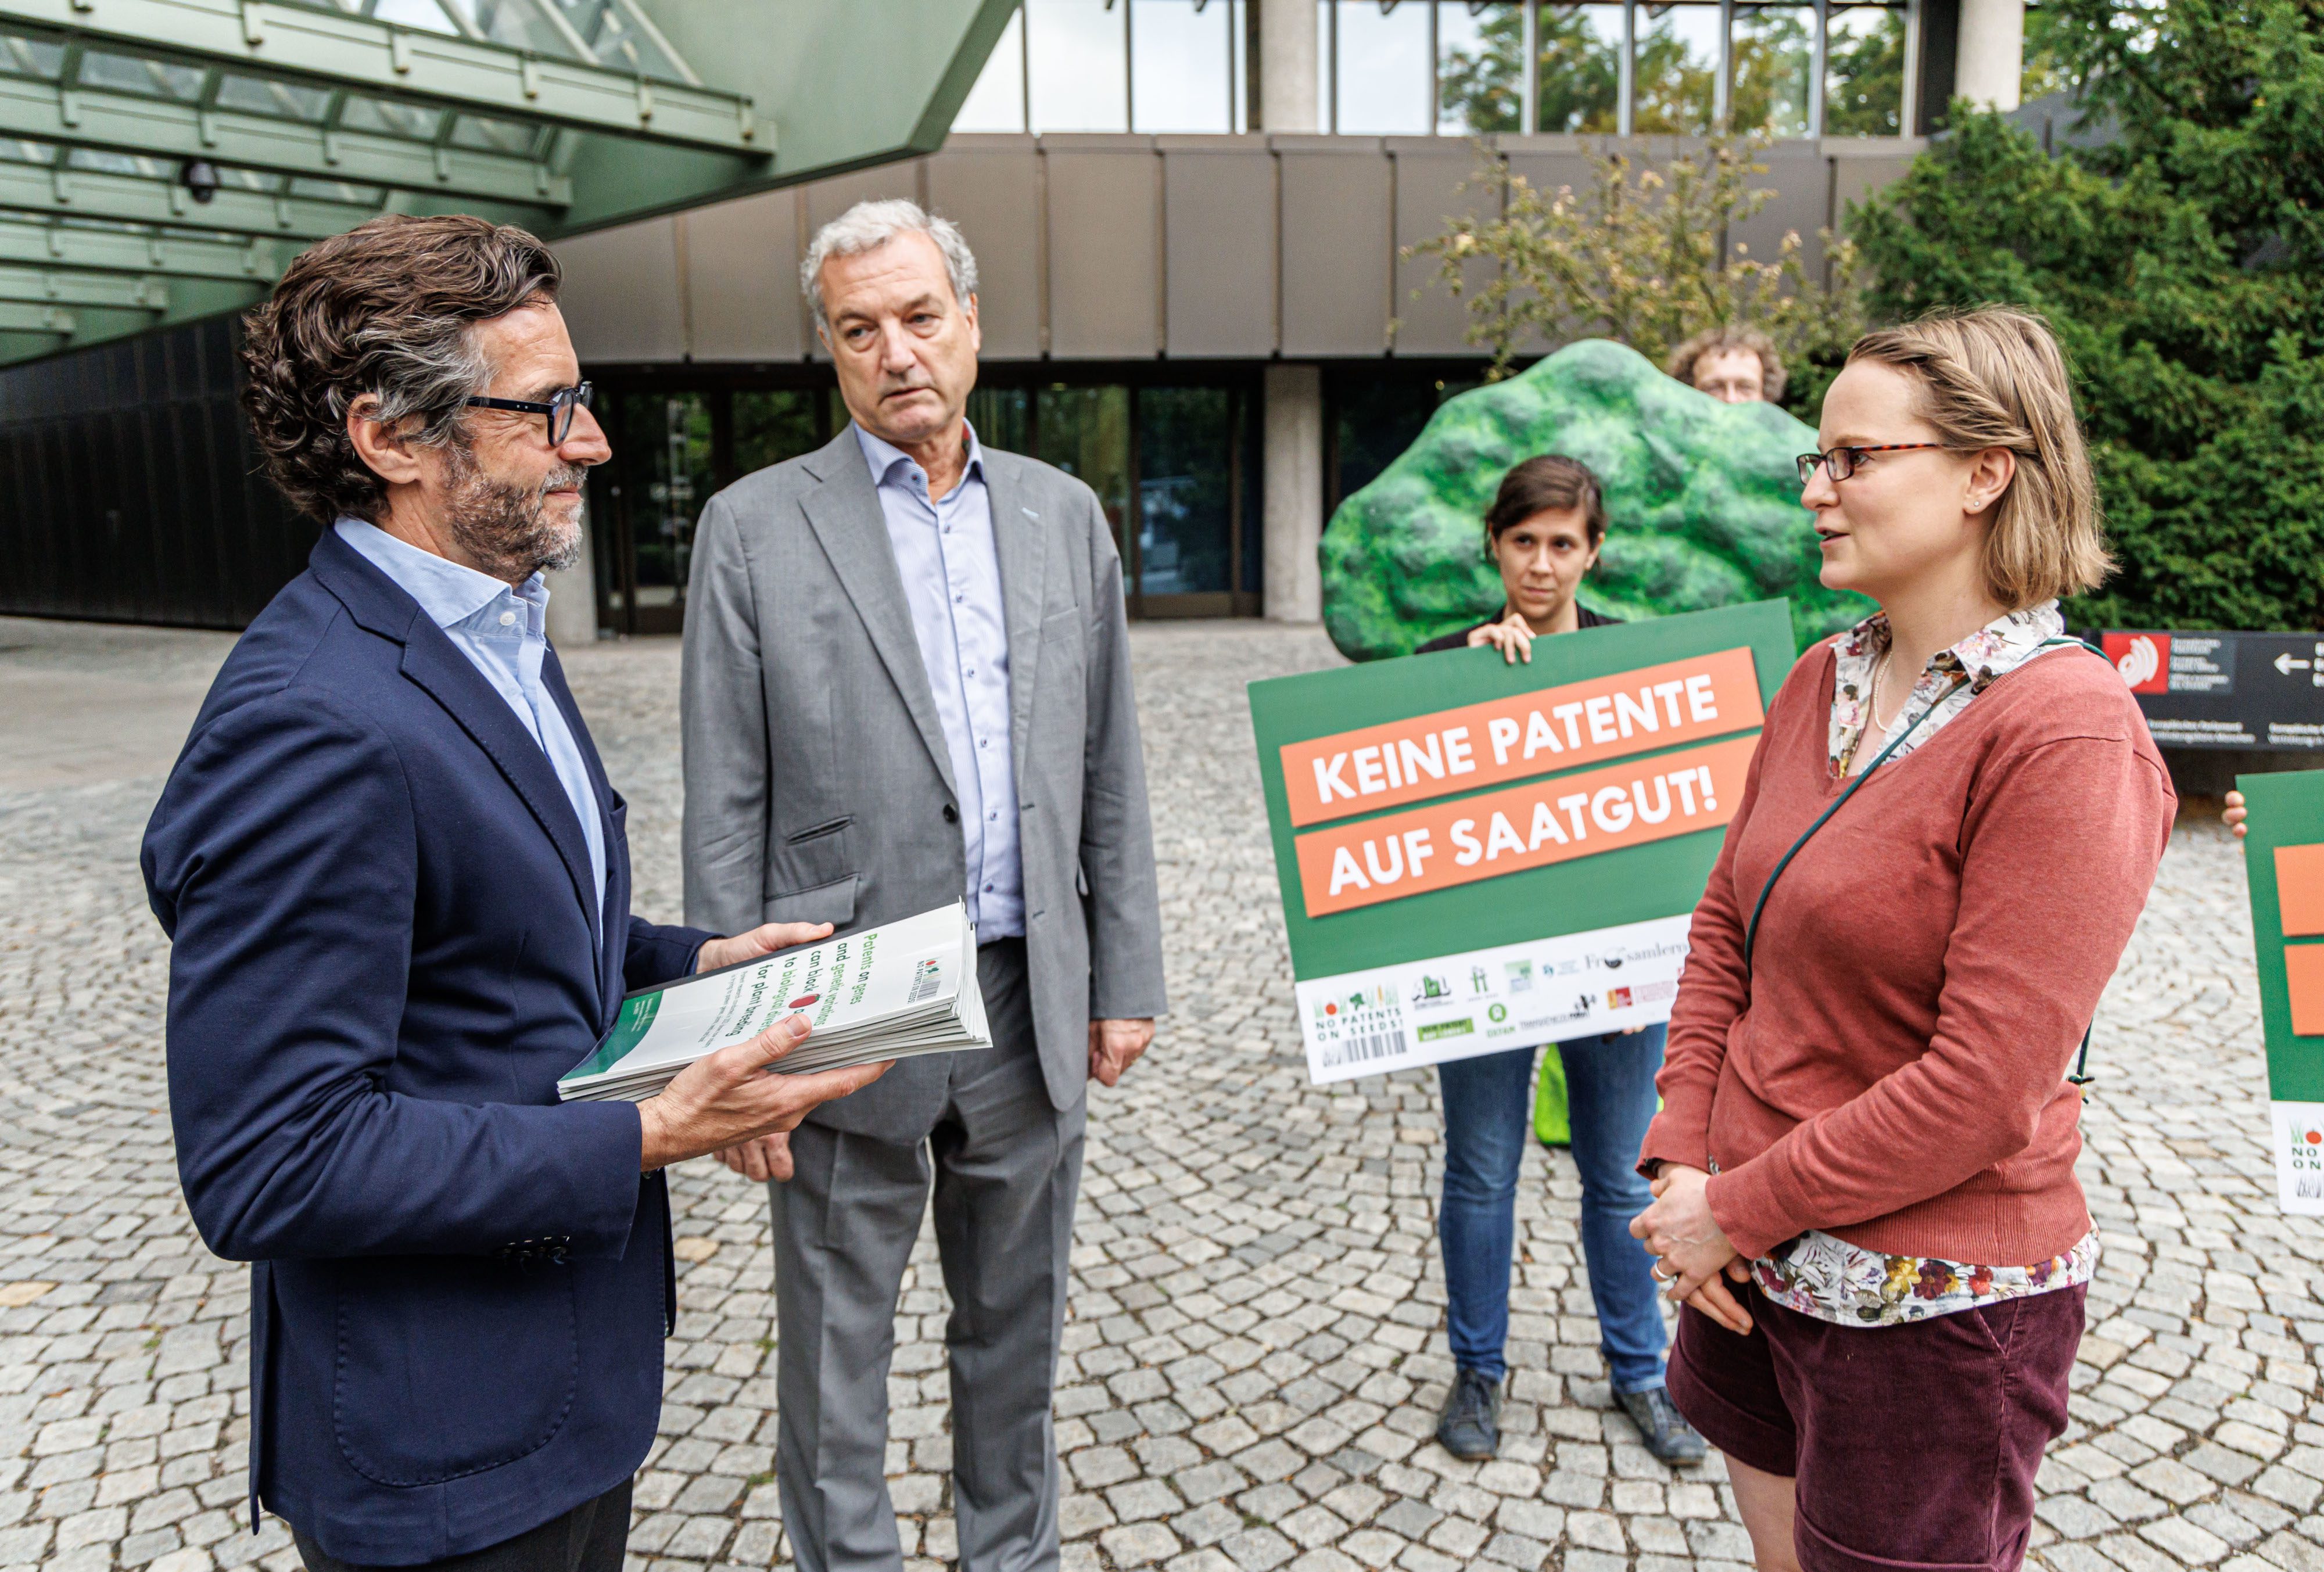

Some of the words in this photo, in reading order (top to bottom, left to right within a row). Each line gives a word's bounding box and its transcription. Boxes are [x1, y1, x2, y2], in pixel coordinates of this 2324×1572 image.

[1312, 727, 1475, 803] KEINE
[1489, 674, 1718, 765] PATENTE
[1329, 828, 1434, 896] AUF
[1450, 766, 1717, 866] SAATGUT!
[809, 950, 821, 968] can
[837, 942, 851, 962] and
[860, 933, 877, 970] Patents
[757, 964, 773, 979] for
[784, 957, 798, 968] to
[803, 968, 823, 993] block
[829, 964, 845, 993] genetic
[858, 971, 869, 982] on
[749, 982, 769, 1005] plant
[770, 968, 798, 1010] biological
[849, 983, 866, 1004] genes
[813, 992, 838, 1027] variations
[1315, 1019, 1335, 1029] NO
[1342, 1008, 1401, 1025] PATENTS
[725, 1004, 762, 1037] breeding
[1318, 1031, 1339, 1042] ON
[2291, 1147, 2317, 1157] NO
[2293, 1159, 2320, 1169] ON
